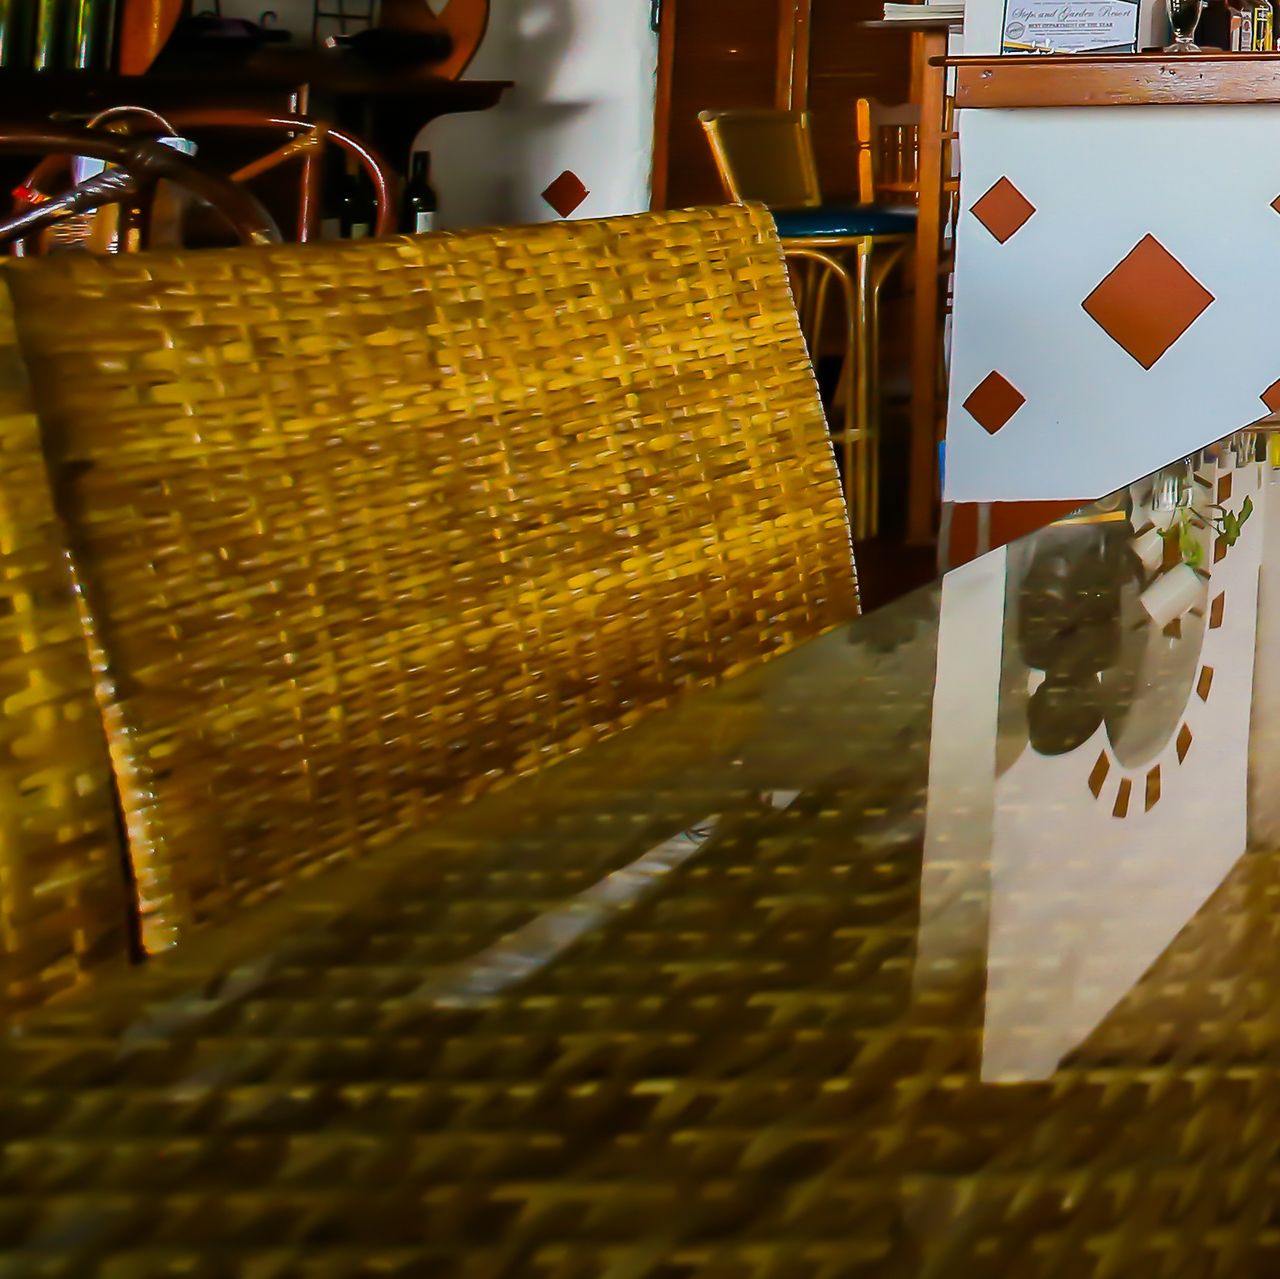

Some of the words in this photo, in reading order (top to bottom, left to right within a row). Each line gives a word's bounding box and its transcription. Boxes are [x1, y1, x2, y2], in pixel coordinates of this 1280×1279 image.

[1037, 8, 1058, 19] and
[1057, 5, 1094, 21] Garden
[1099, 5, 1131, 17] Resort
